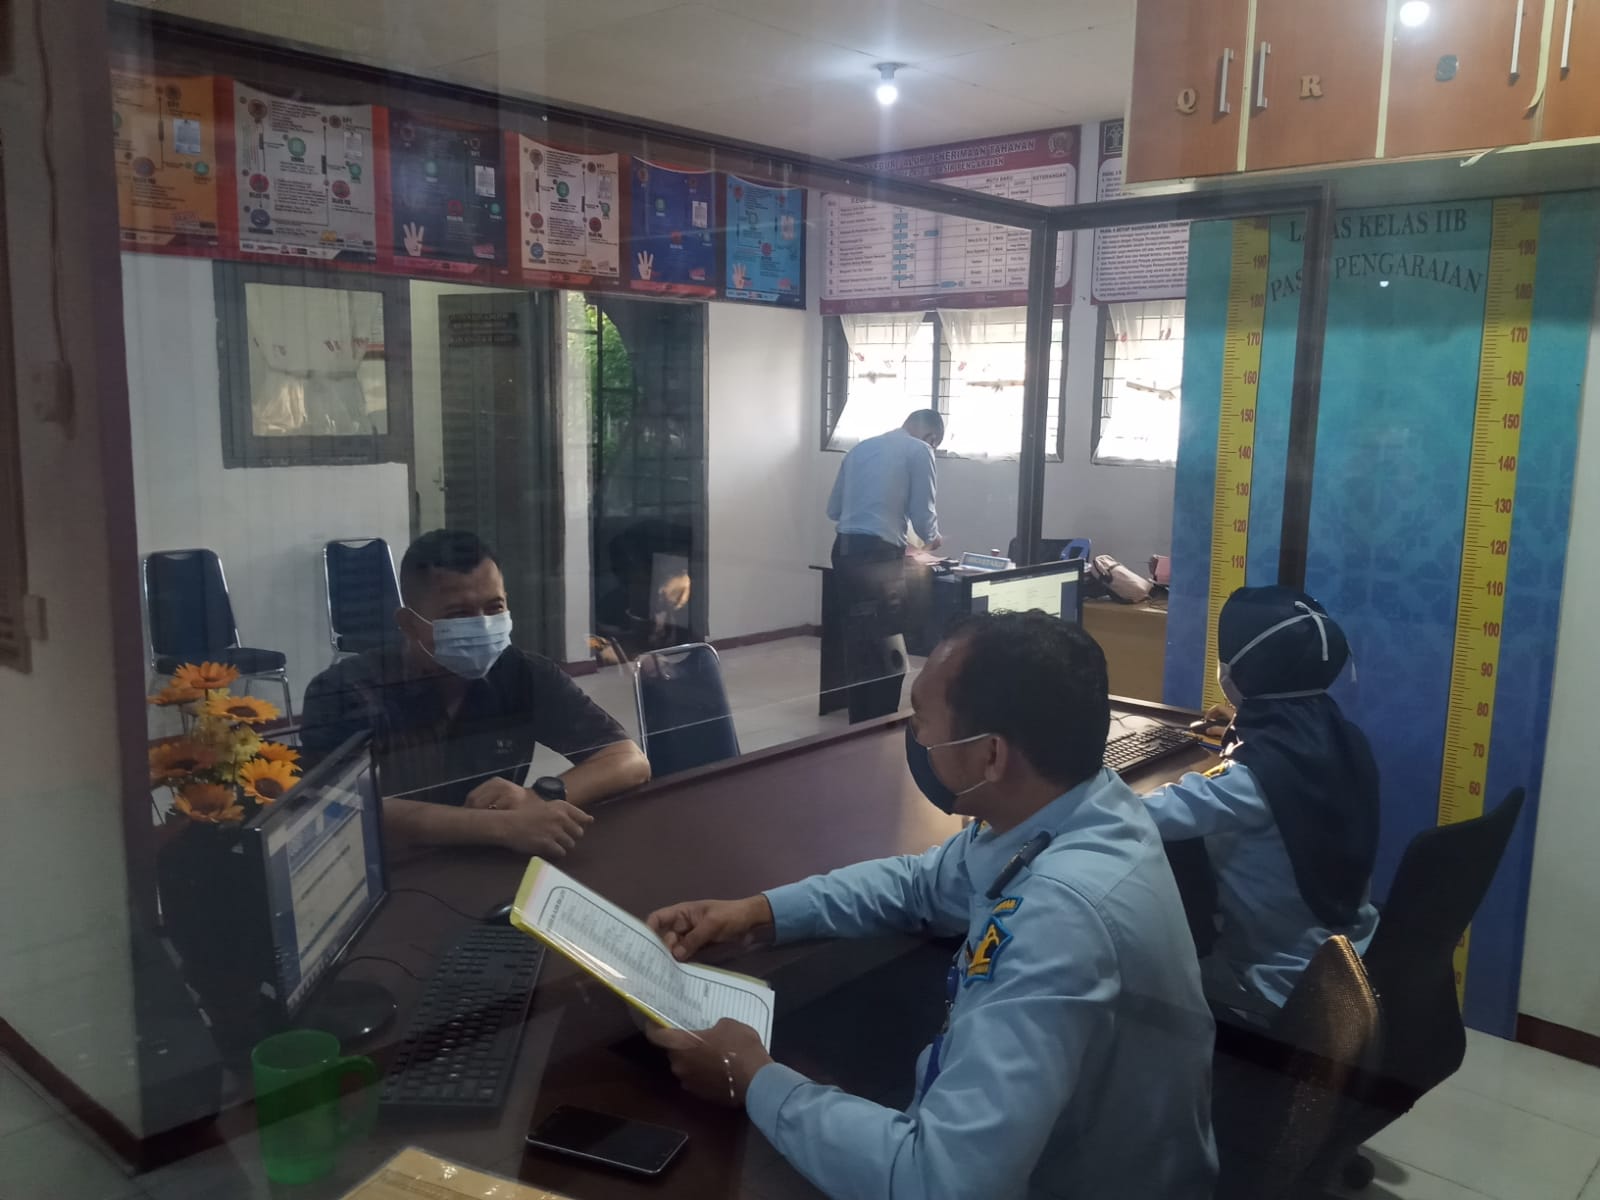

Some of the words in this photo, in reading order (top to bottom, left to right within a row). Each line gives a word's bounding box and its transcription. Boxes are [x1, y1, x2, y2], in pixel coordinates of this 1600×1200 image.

[1299, 73, 1323, 98] R
[1175, 87, 1197, 115] Q
[1359, 211, 1428, 239] KELAS
[1436, 208, 1467, 233] IIB
[1253, 255, 1267, 269] 190
[1335, 252, 1485, 295] PENGARAIAN
[1247, 332, 1260, 346] 170
[1510, 327, 1528, 343] 170
[1243, 370, 1257, 385] 160
[1506, 370, 1524, 386] 160
[1240, 408, 1254, 423] 150
[1502, 413, 1520, 429] 150
[1238, 446, 1252, 460] 140
[1498, 456, 1516, 472] 140
[1236, 483, 1249, 497] 130
[1494, 498, 1512, 514] 130
[1233, 519, 1246, 533] 120
[1490, 539, 1507, 555] 120
[1231, 555, 1244, 569] 110
[1486, 580, 1503, 597] 110
[1483, 621, 1500, 637] 100
[1481, 662, 1493, 677] 90
[1477, 702, 1489, 717] 80
[1473, 742, 1485, 758] 70
[1469, 781, 1481, 796] 60
